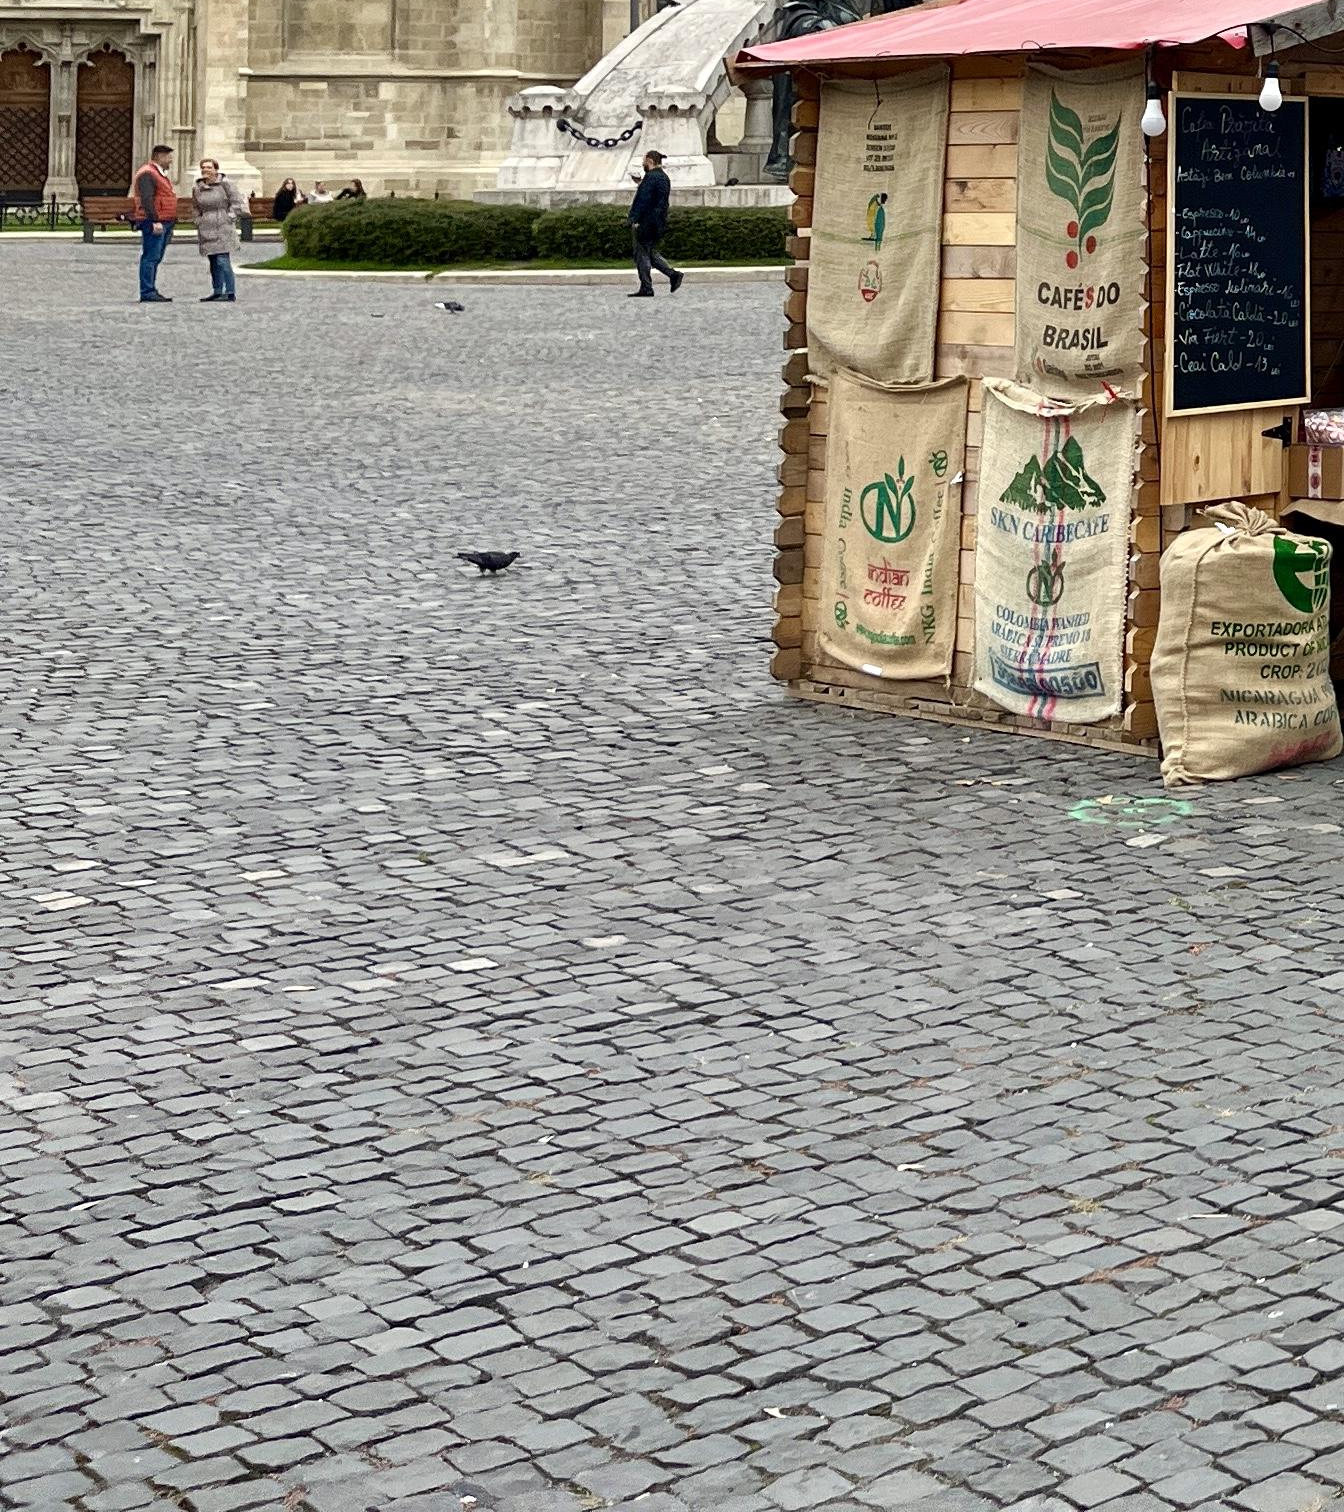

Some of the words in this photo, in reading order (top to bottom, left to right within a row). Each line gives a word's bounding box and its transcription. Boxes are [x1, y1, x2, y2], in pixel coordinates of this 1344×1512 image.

[1037, 281, 1096, 311] CAFÉS
[1096, 281, 1120, 308] DO
[1042, 324, 1109, 351] BRASIL
[990, 506, 1021, 535] SKN
[1210, 620, 1315, 638] EXPORTADORA
[1224, 641, 1300, 658] PRODUCT
[1302, 641, 1316, 657] OF
[1219, 687, 1320, 706] NICARAGUA
[1233, 709, 1309, 729] ARABICA
